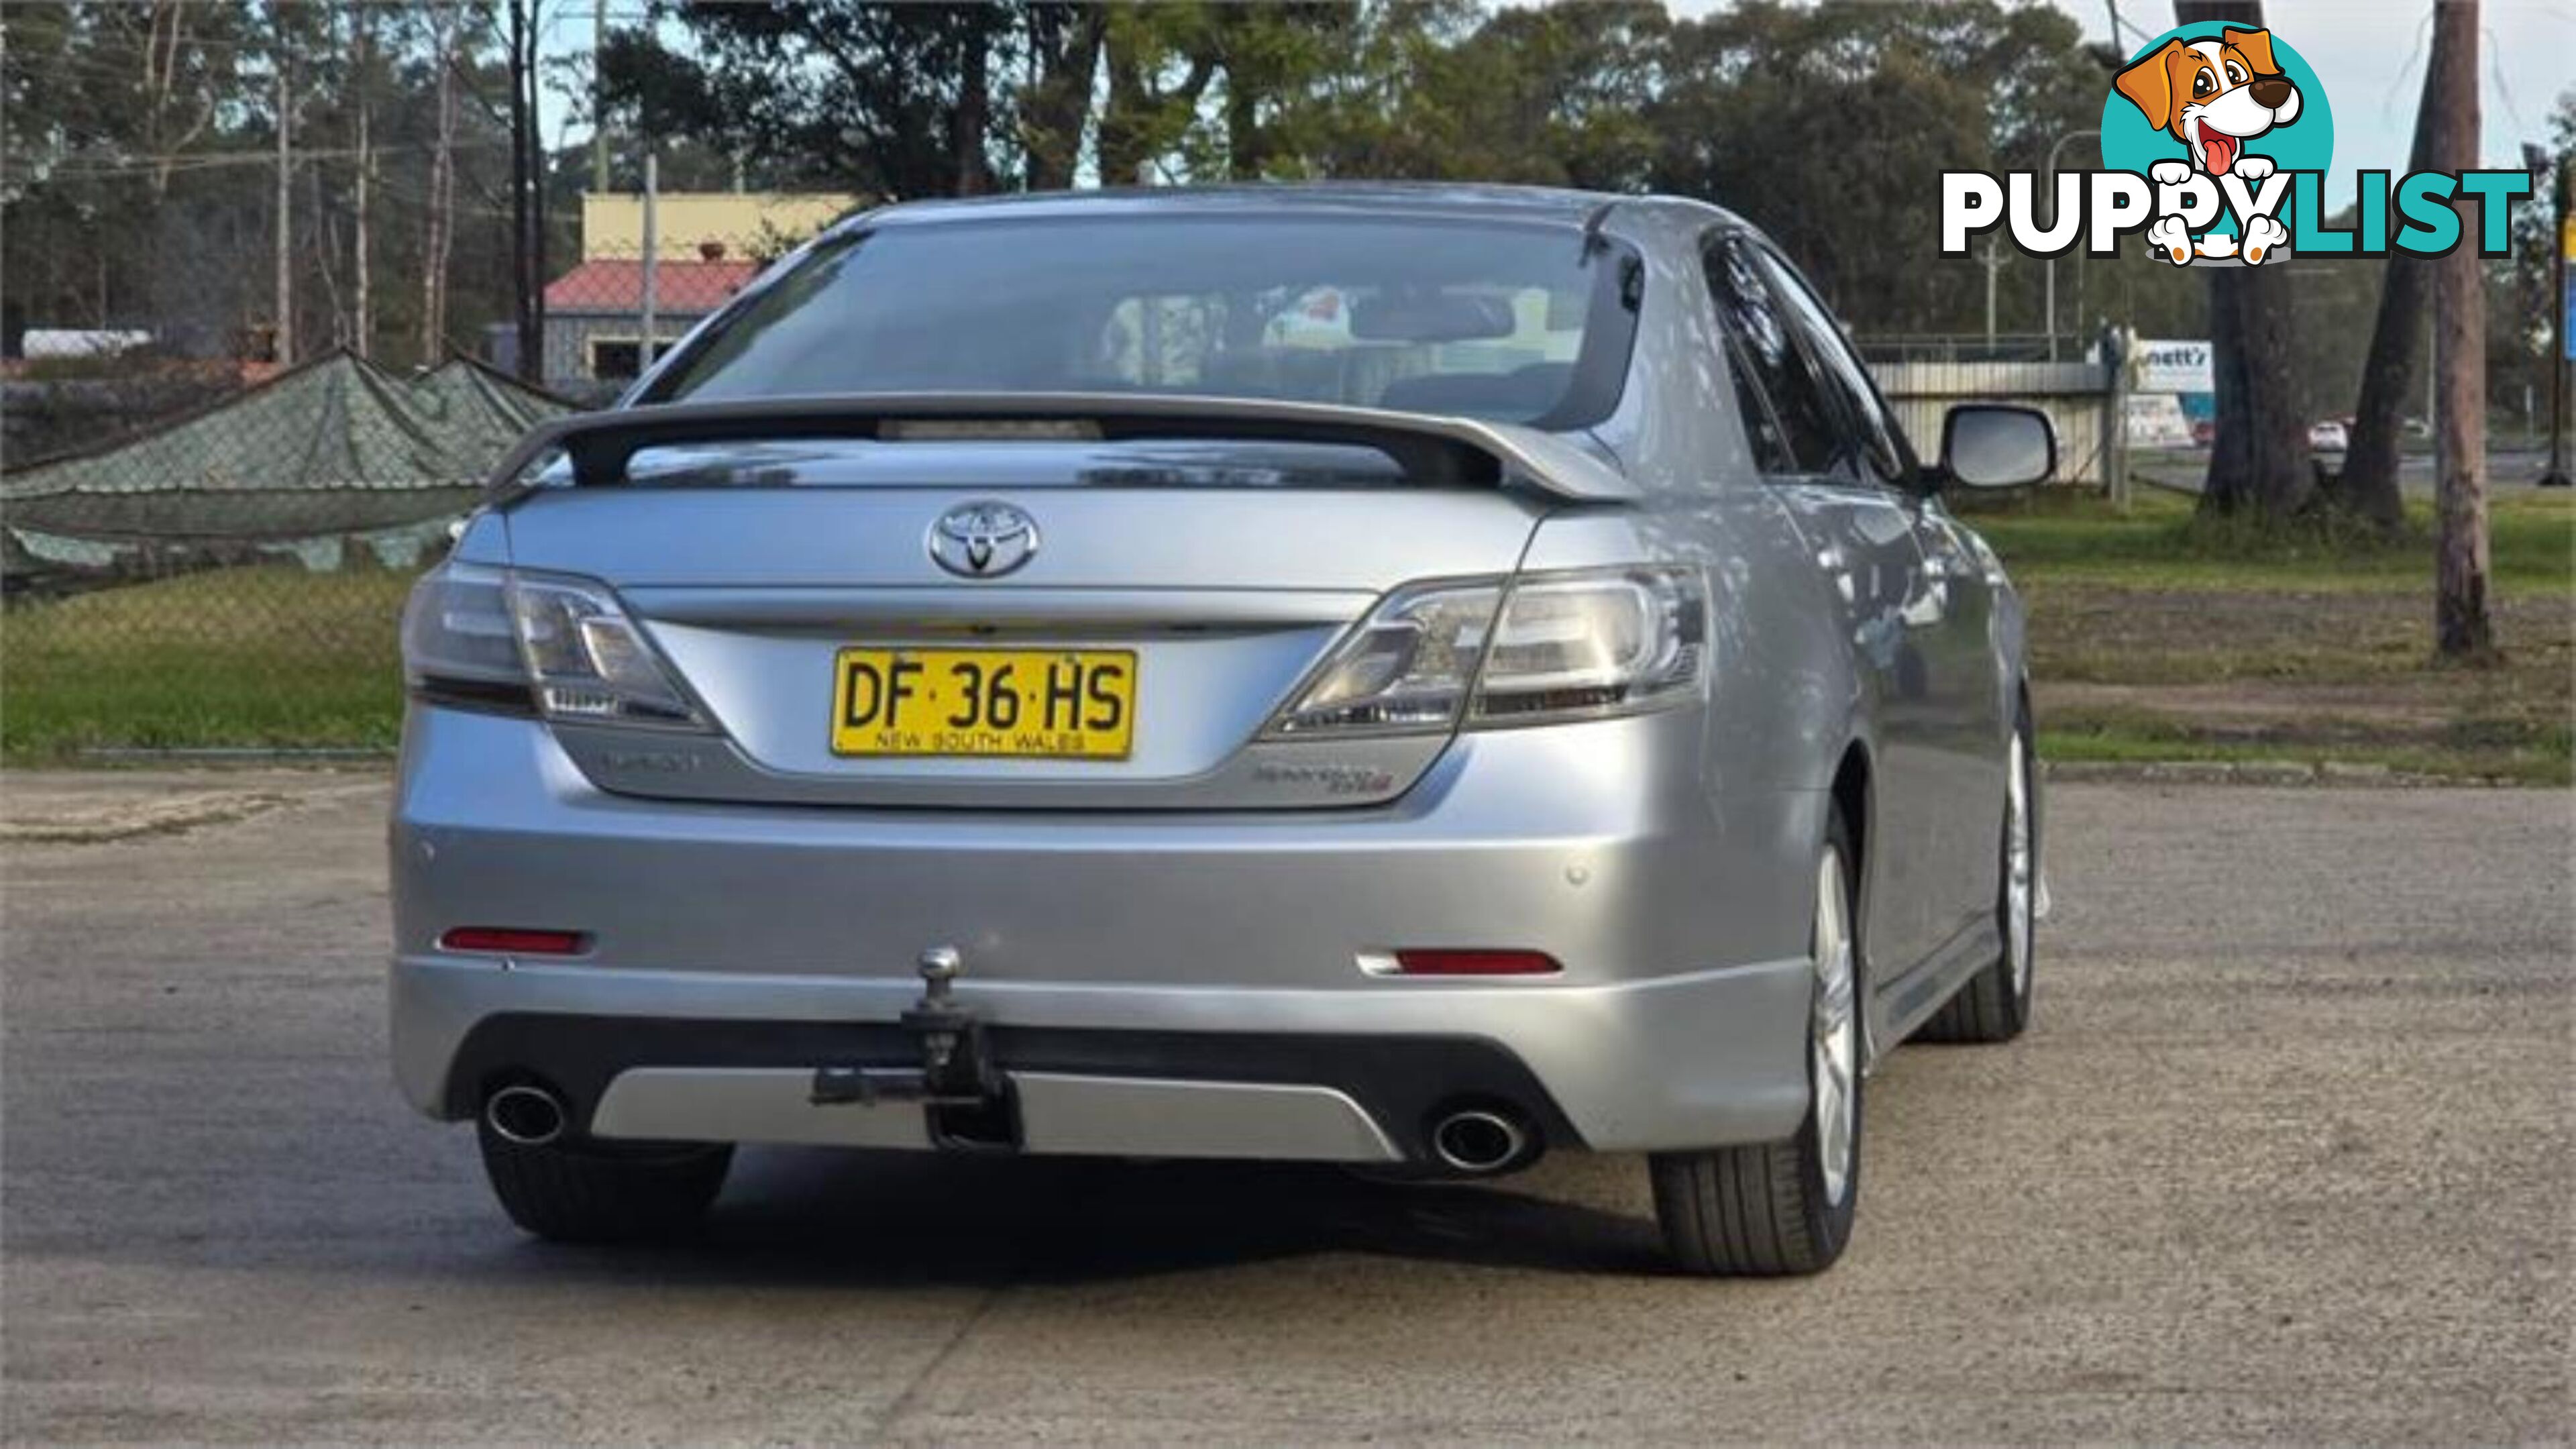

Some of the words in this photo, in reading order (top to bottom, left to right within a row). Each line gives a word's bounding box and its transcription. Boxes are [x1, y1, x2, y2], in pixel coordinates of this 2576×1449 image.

[875, 732, 921, 748] NEW
[933, 733, 1002, 749] SOUTH
[1016, 733, 1085, 751] WALES
